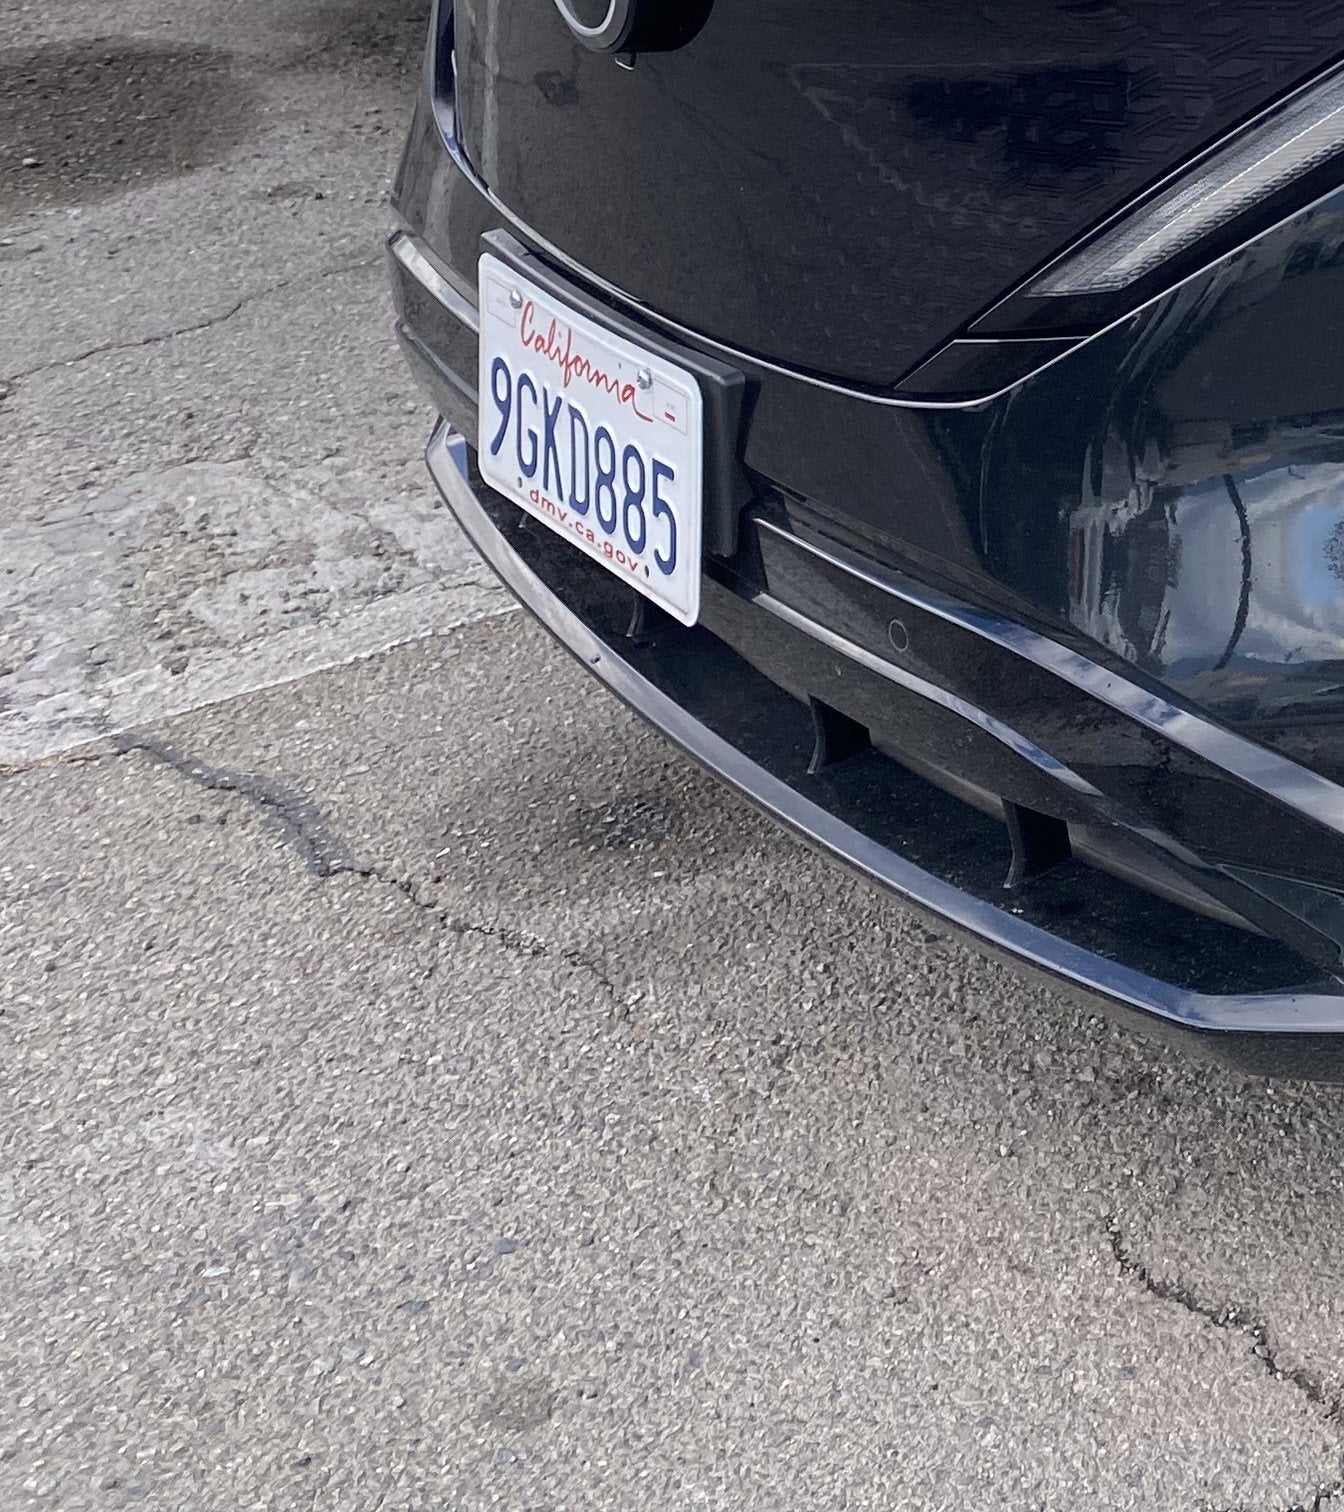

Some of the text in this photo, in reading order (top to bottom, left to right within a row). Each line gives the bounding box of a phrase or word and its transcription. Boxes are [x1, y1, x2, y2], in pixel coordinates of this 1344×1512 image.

[520, 300, 654, 423] California
[490, 356, 676, 577] 9GKD885
[529, 487, 639, 573] dmv.ca.gov
